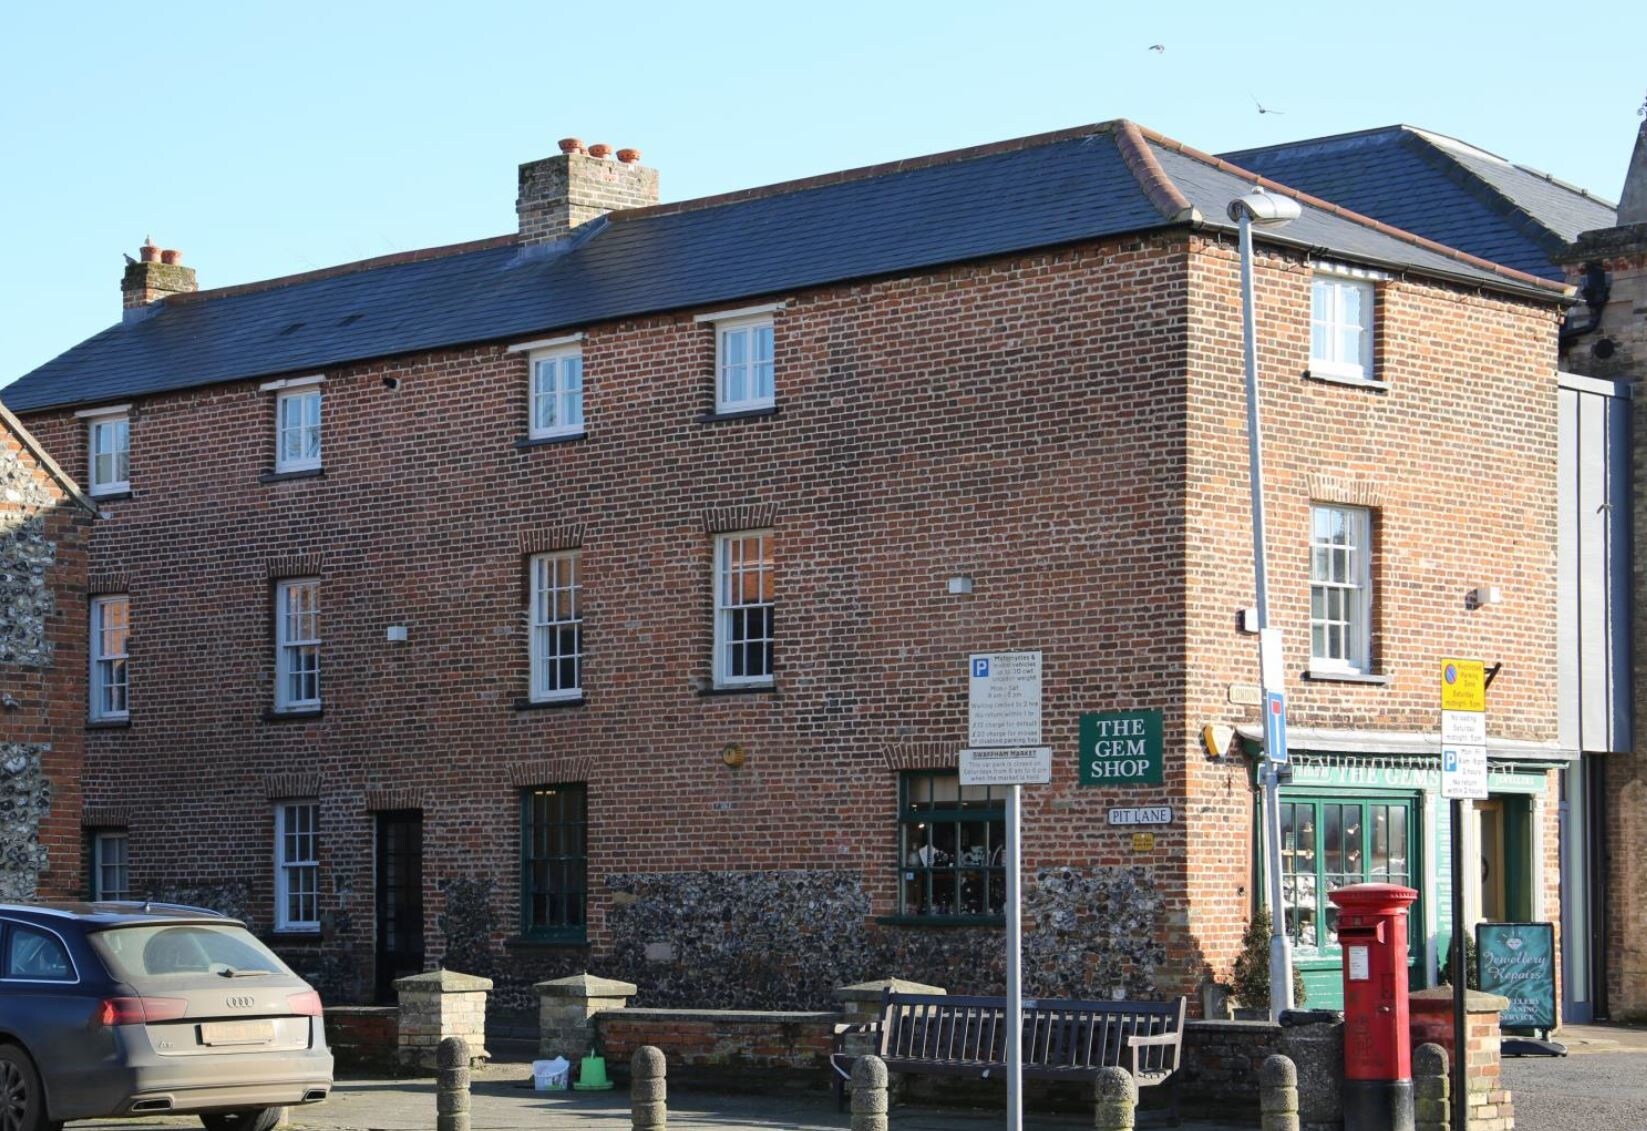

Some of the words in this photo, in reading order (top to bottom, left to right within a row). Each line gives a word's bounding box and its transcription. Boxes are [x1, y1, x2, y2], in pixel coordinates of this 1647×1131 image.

[977, 660, 987, 676] P
[1096, 719, 1145, 737] THE
[1095, 739, 1146, 758] GEM
[1091, 760, 1150, 778] SHOP
[1446, 752, 1455, 770] P
[1338, 767, 1378, 784] THE
[1112, 810, 1131, 822] PIT
[1135, 810, 1167, 822] LANE
[1483, 951, 1545, 968] Jewellery
[1488, 967, 1543, 983] Repairs
